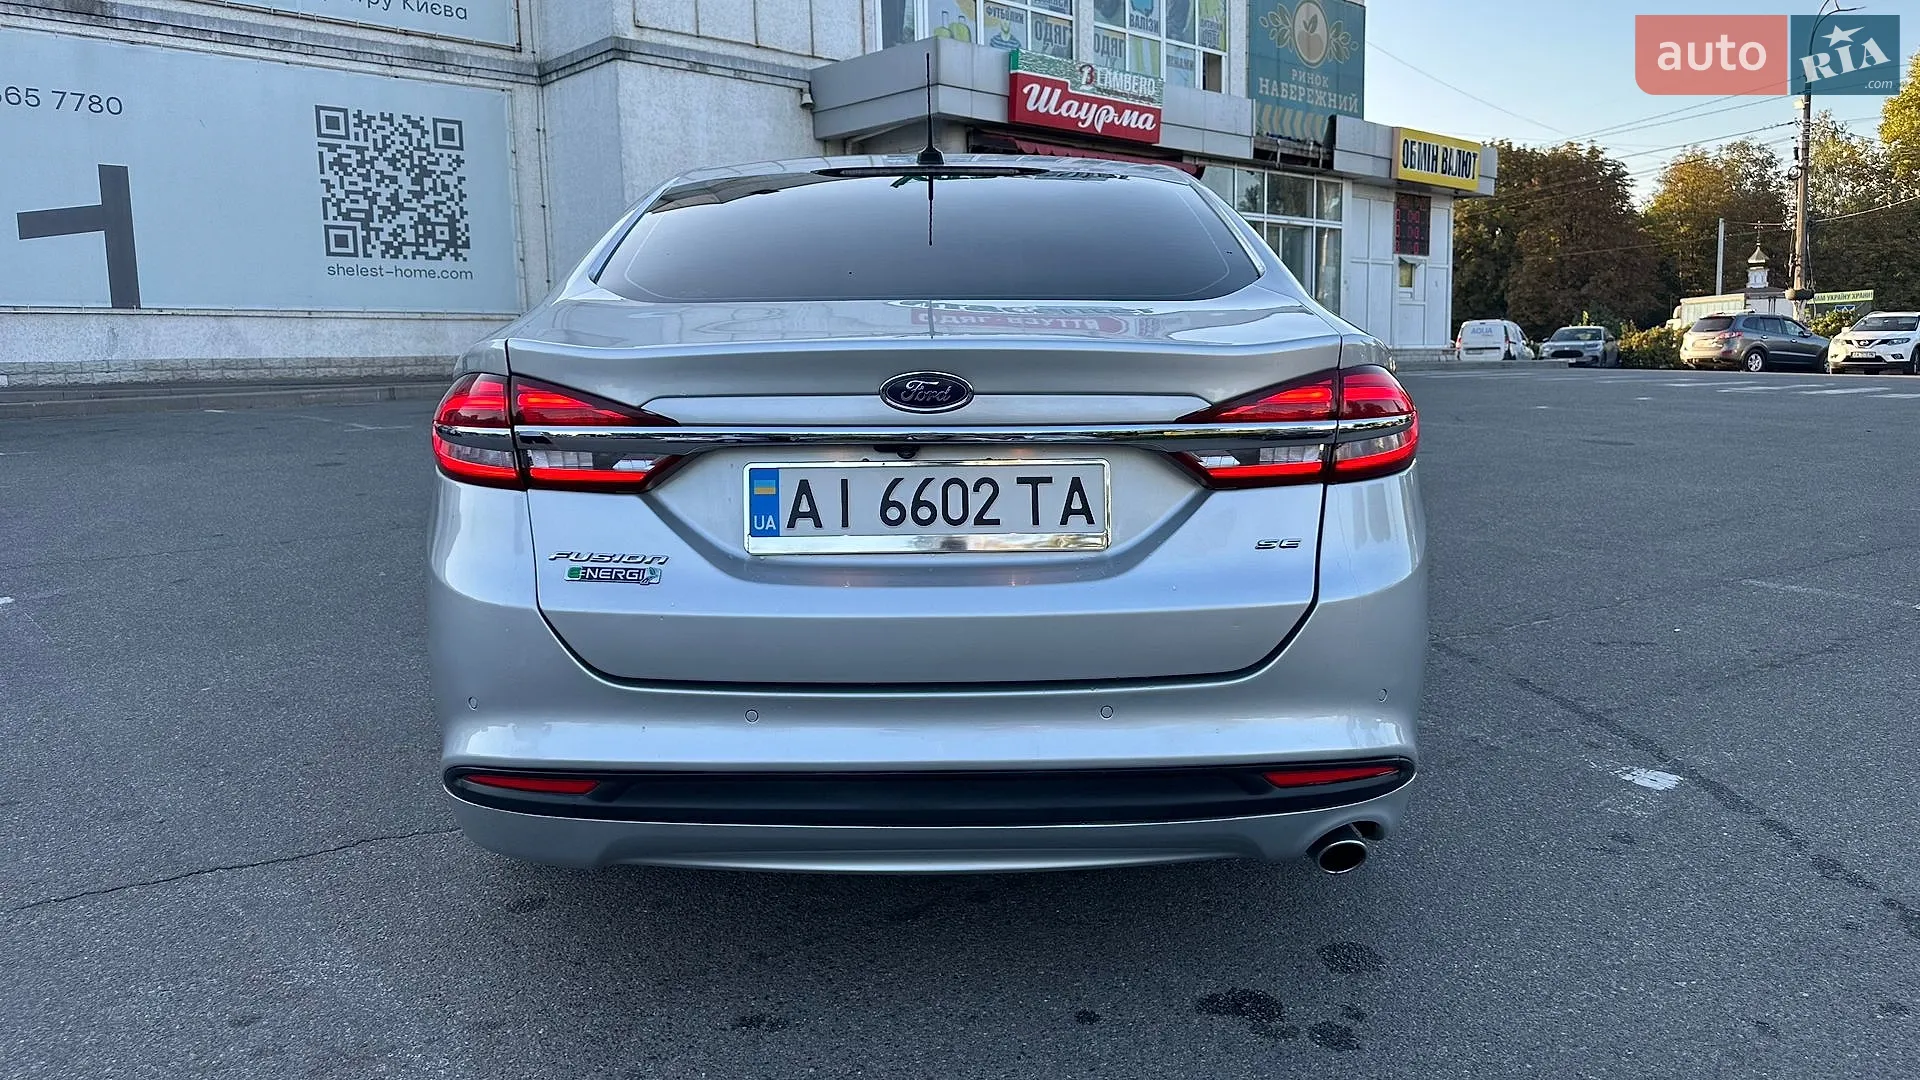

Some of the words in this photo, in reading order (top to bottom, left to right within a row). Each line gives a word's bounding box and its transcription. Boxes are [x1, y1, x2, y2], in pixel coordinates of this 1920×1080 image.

[402, 0, 468, 20] Києва
[1034, 19, 1072, 48] ОДЯГ
[1093, 32, 1125, 58] ОДЯГ
[1291, 68, 1329, 89] РИНОК
[0, 86, 41, 107] 65
[51, 90, 123, 116] 7780
[1258, 76, 1359, 113] НАБЕРЕЖНИЙ
[1022, 83, 1157, 134] Шаурма
[1402, 138, 1439, 174] ОБМІН
[1441, 147, 1479, 180] ВАЛЮТ
[326, 263, 474, 281] shelest-home.com
[900, 380, 952, 402] Ford
[787, 478, 849, 529] AI
[879, 477, 1001, 527] 6602
[1016, 476, 1096, 527] TA
[754, 515, 777, 531] UA
[1254, 538, 1302, 550] SE
[548, 550, 670, 565] FUSION
